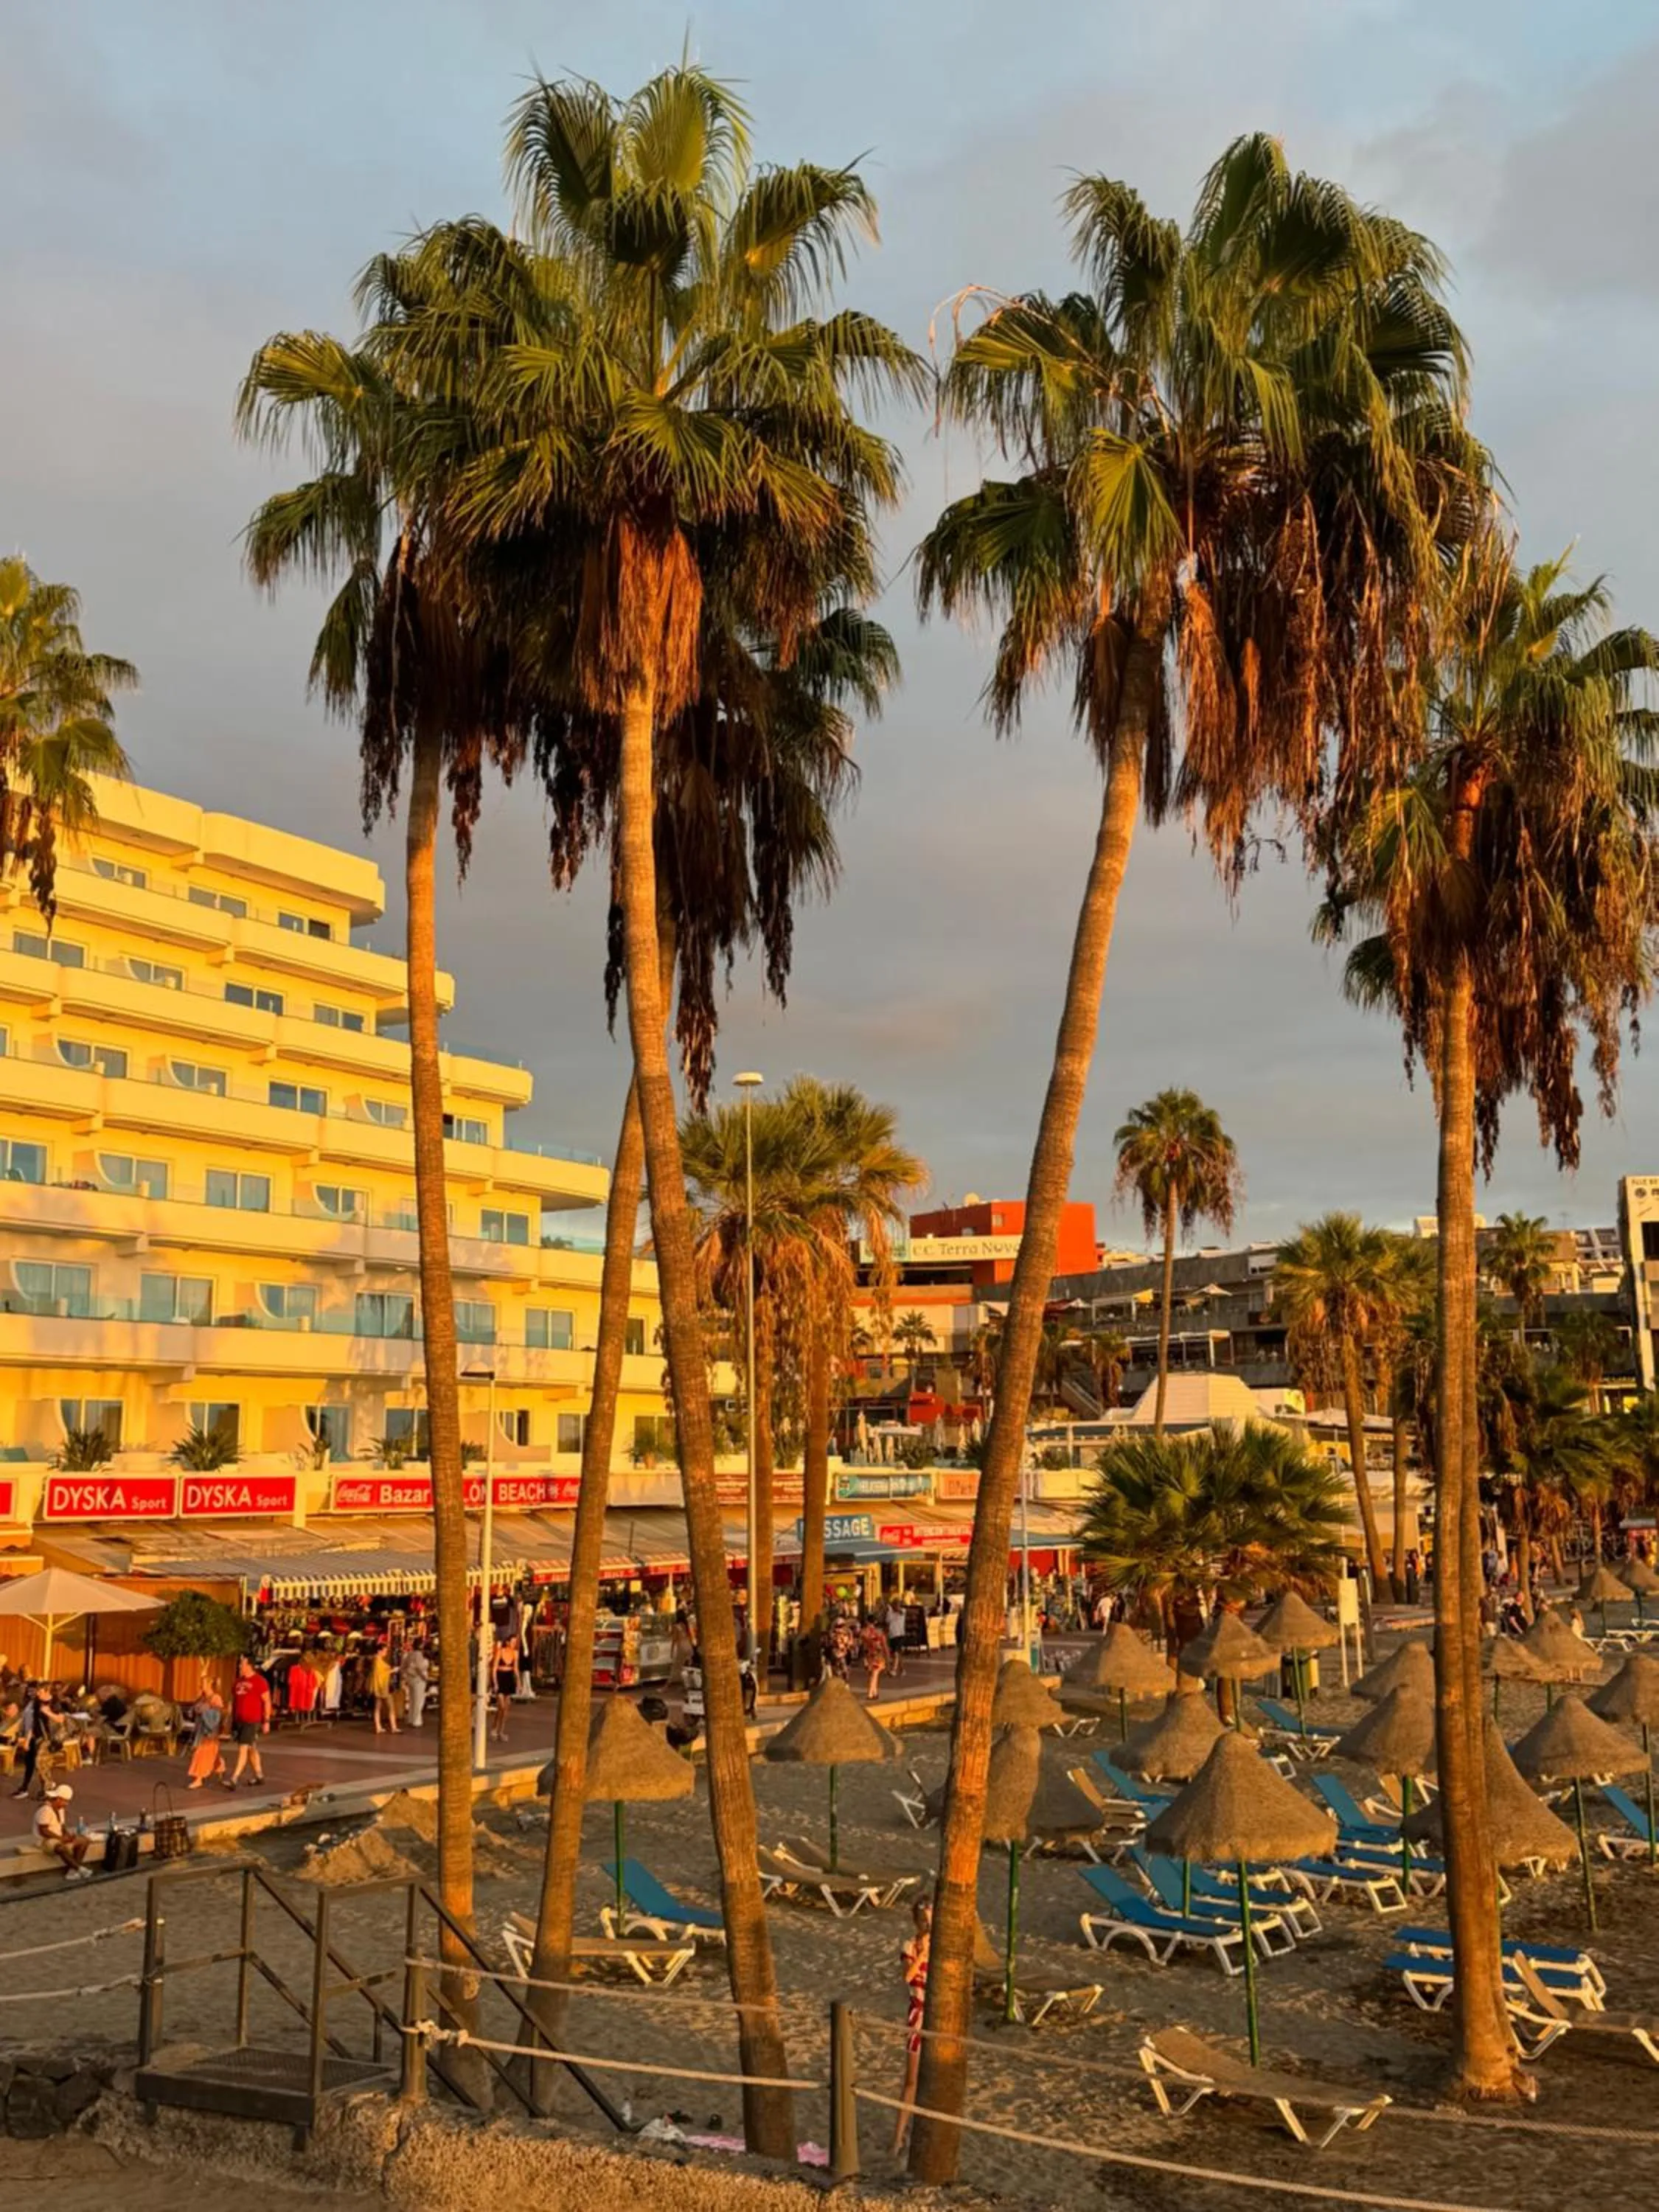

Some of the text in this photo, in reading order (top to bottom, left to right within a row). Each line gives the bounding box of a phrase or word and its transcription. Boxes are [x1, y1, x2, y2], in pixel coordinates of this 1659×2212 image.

[938, 1242, 978, 1256] Terra
[53, 1485, 167, 1512] DYSKA Sport
[187, 1484, 288, 1509] DYSKA Sport
[379, 1484, 431, 1504] Bazar
[498, 1482, 546, 1502] BEACH
